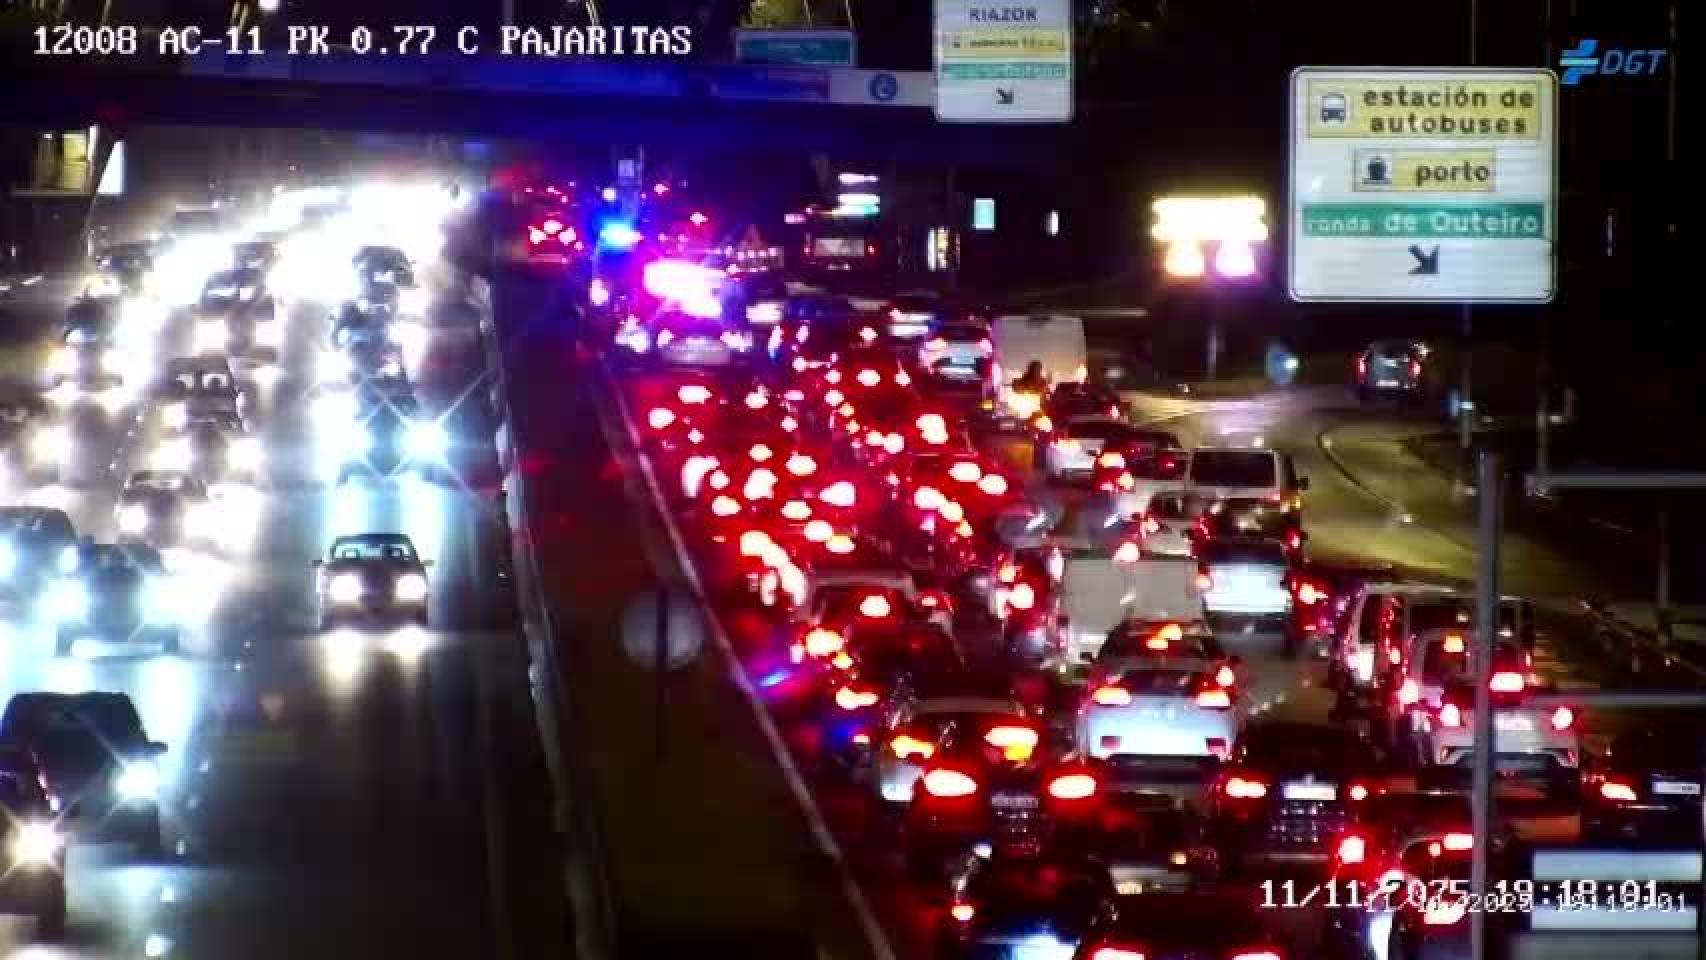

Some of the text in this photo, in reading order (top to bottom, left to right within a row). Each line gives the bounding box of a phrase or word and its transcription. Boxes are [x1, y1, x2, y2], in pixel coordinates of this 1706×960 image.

[1363, 86, 1535, 107] estación de
[1371, 113, 1526, 135] autobuses
[1415, 160, 1490, 187] porto
[1306, 211, 1541, 233] ronda de Outeiro
